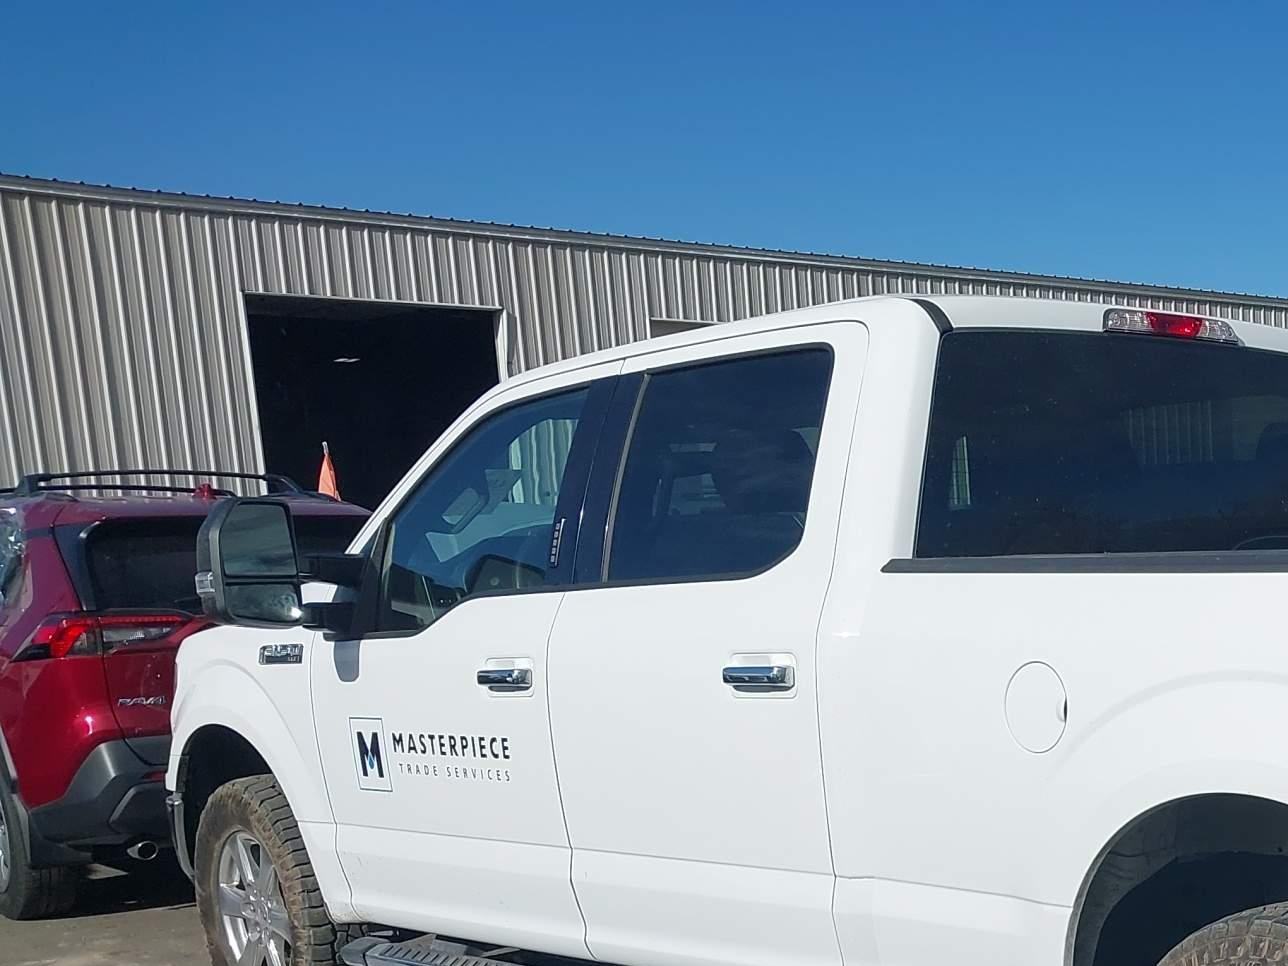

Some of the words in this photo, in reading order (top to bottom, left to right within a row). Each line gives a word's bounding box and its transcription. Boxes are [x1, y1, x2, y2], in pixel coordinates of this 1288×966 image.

[391, 732, 510, 759] MASTERPIECE
[399, 763, 438, 777] TRADE
[447, 766, 510, 782] SERVICES
